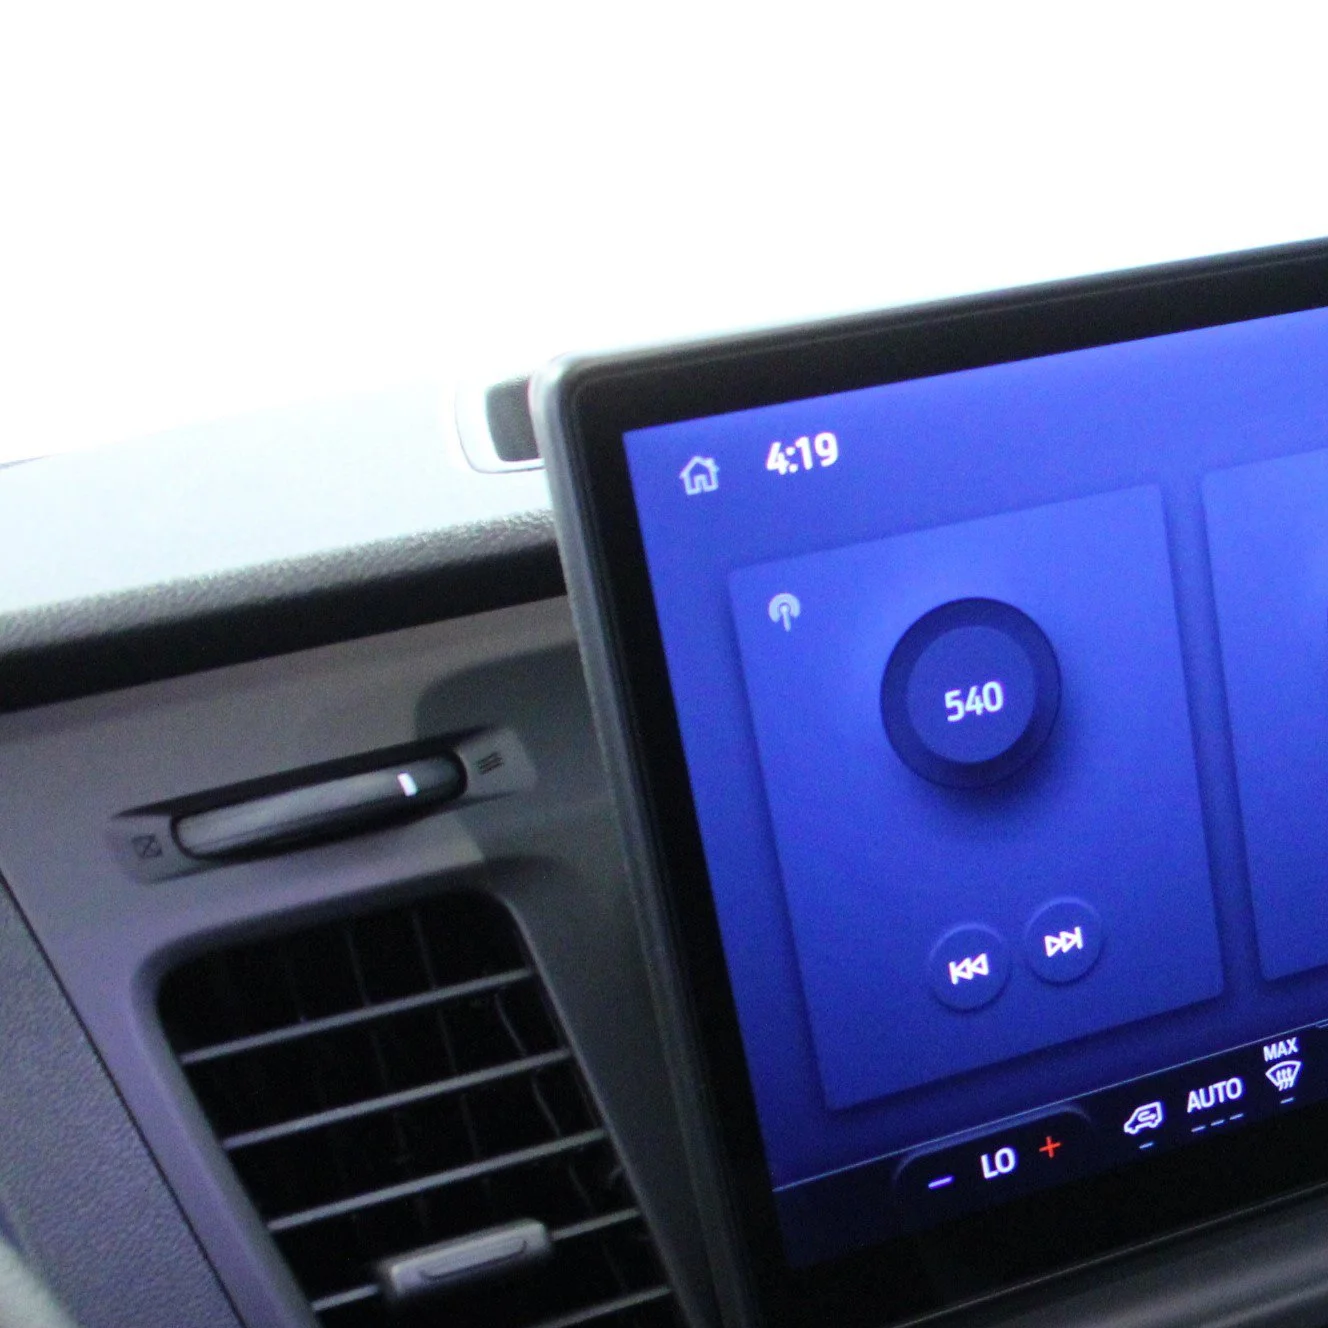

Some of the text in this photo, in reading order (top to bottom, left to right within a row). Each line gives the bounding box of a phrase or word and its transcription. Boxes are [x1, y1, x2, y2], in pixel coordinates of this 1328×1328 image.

[765, 432, 839, 475] 4:19
[944, 681, 1004, 721] 540
[1263, 1037, 1297, 1062] MAX
[1186, 1077, 1243, 1113] AUTO
[981, 1148, 1016, 1180] LO
